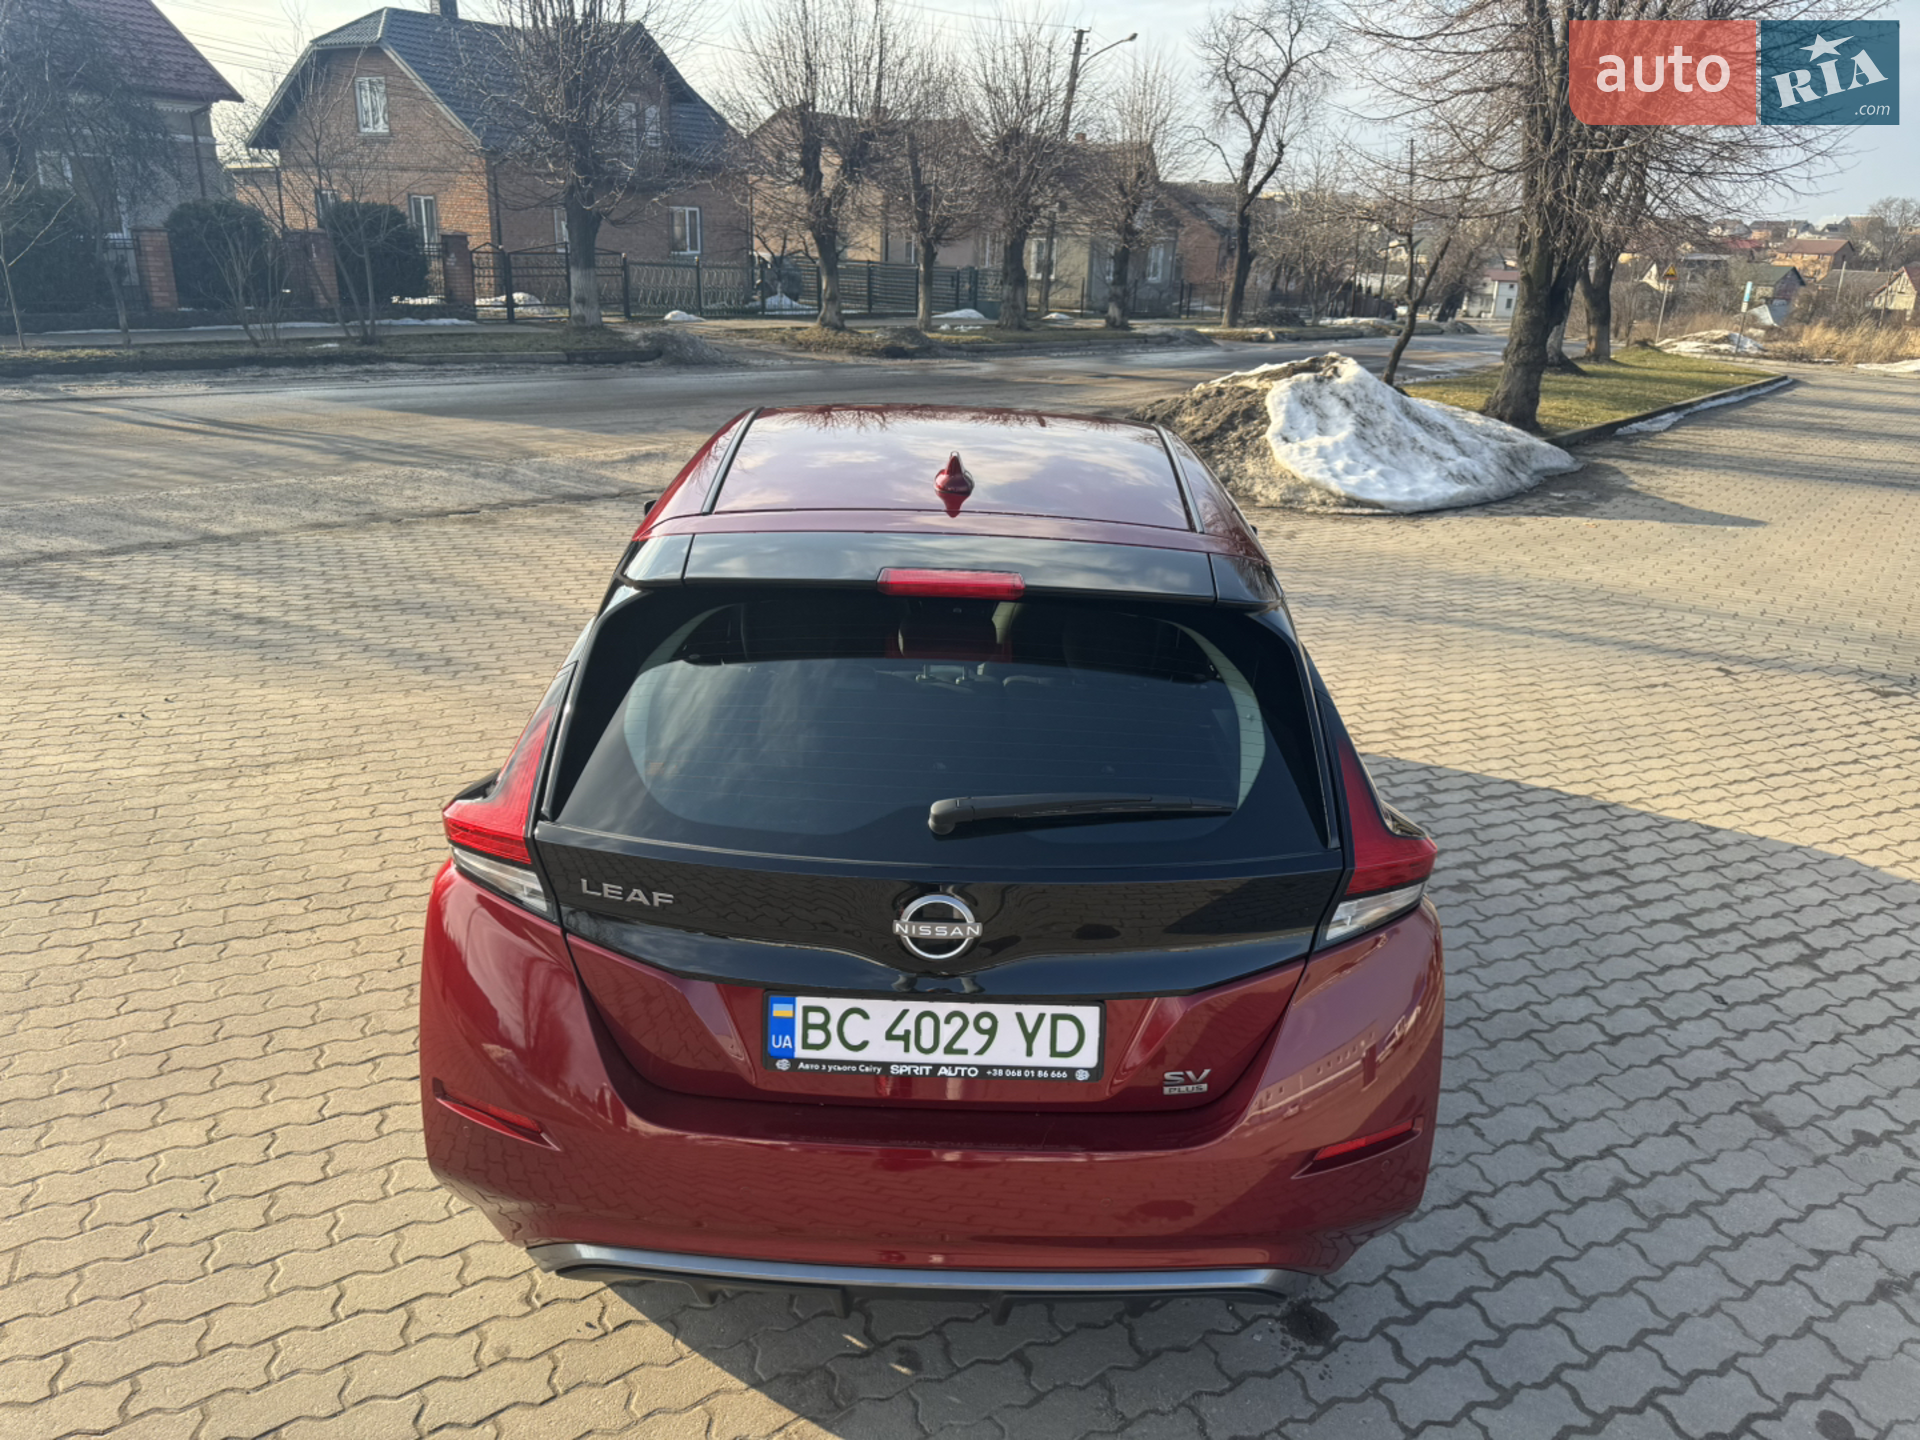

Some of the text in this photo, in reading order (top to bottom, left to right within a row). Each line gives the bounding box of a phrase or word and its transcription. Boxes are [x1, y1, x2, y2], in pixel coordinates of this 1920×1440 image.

[581, 878, 674, 908] LEAF
[894, 921, 981, 937] NISSAN
[801, 1005, 1086, 1058] BC 4029 YD
[772, 1034, 793, 1049] UA
[890, 1064, 979, 1077] SPRIT AUTO
[1023, 1069, 1035, 1078] 01
[1050, 1070, 1068, 1078] 666
[1163, 1068, 1212, 1086] SV
[1168, 1084, 1204, 1093] PLUS
